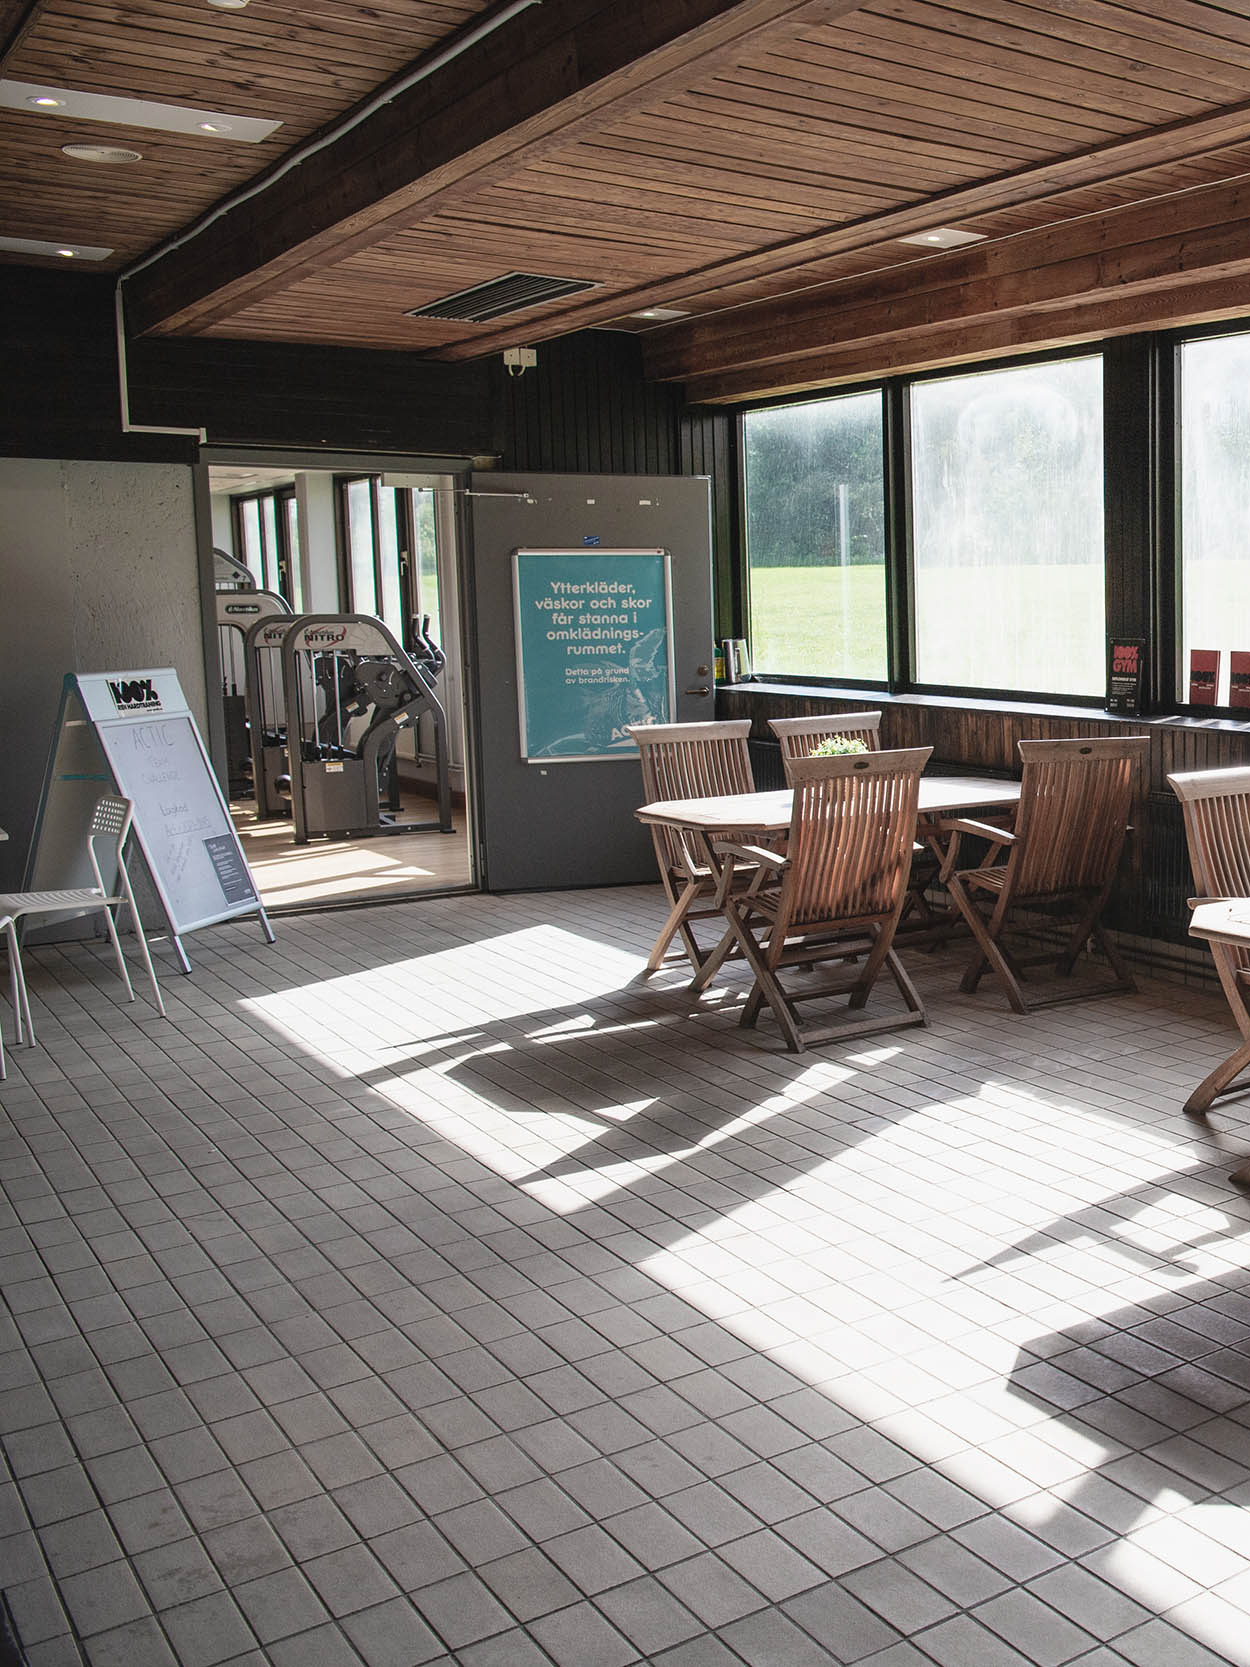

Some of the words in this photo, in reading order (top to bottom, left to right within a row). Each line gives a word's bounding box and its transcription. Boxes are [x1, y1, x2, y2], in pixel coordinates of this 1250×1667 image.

[550, 581, 636, 595] Ytterkläder,
[535, 597, 585, 610] väskor
[590, 597, 617, 609] och
[621, 597, 652, 609] skor
[552, 612, 574, 625] får
[578, 613, 629, 625] stanna
[632, 611, 638, 624] i
[263, 632, 283, 640] NIT
[304, 633, 345, 642] NITRO
[546, 627, 645, 641] omklädnings-
[567, 643, 626, 655] rummet.
[565, 668, 589, 676] Detta
[591, 667, 602, 677] på
[605, 667, 630, 677] grund
[1113, 659, 1138, 673] GYM
[578, 676, 631, 685] brandrisken.
[110, 680, 159, 704] 100%
[132, 724, 174, 752] ACTIC
